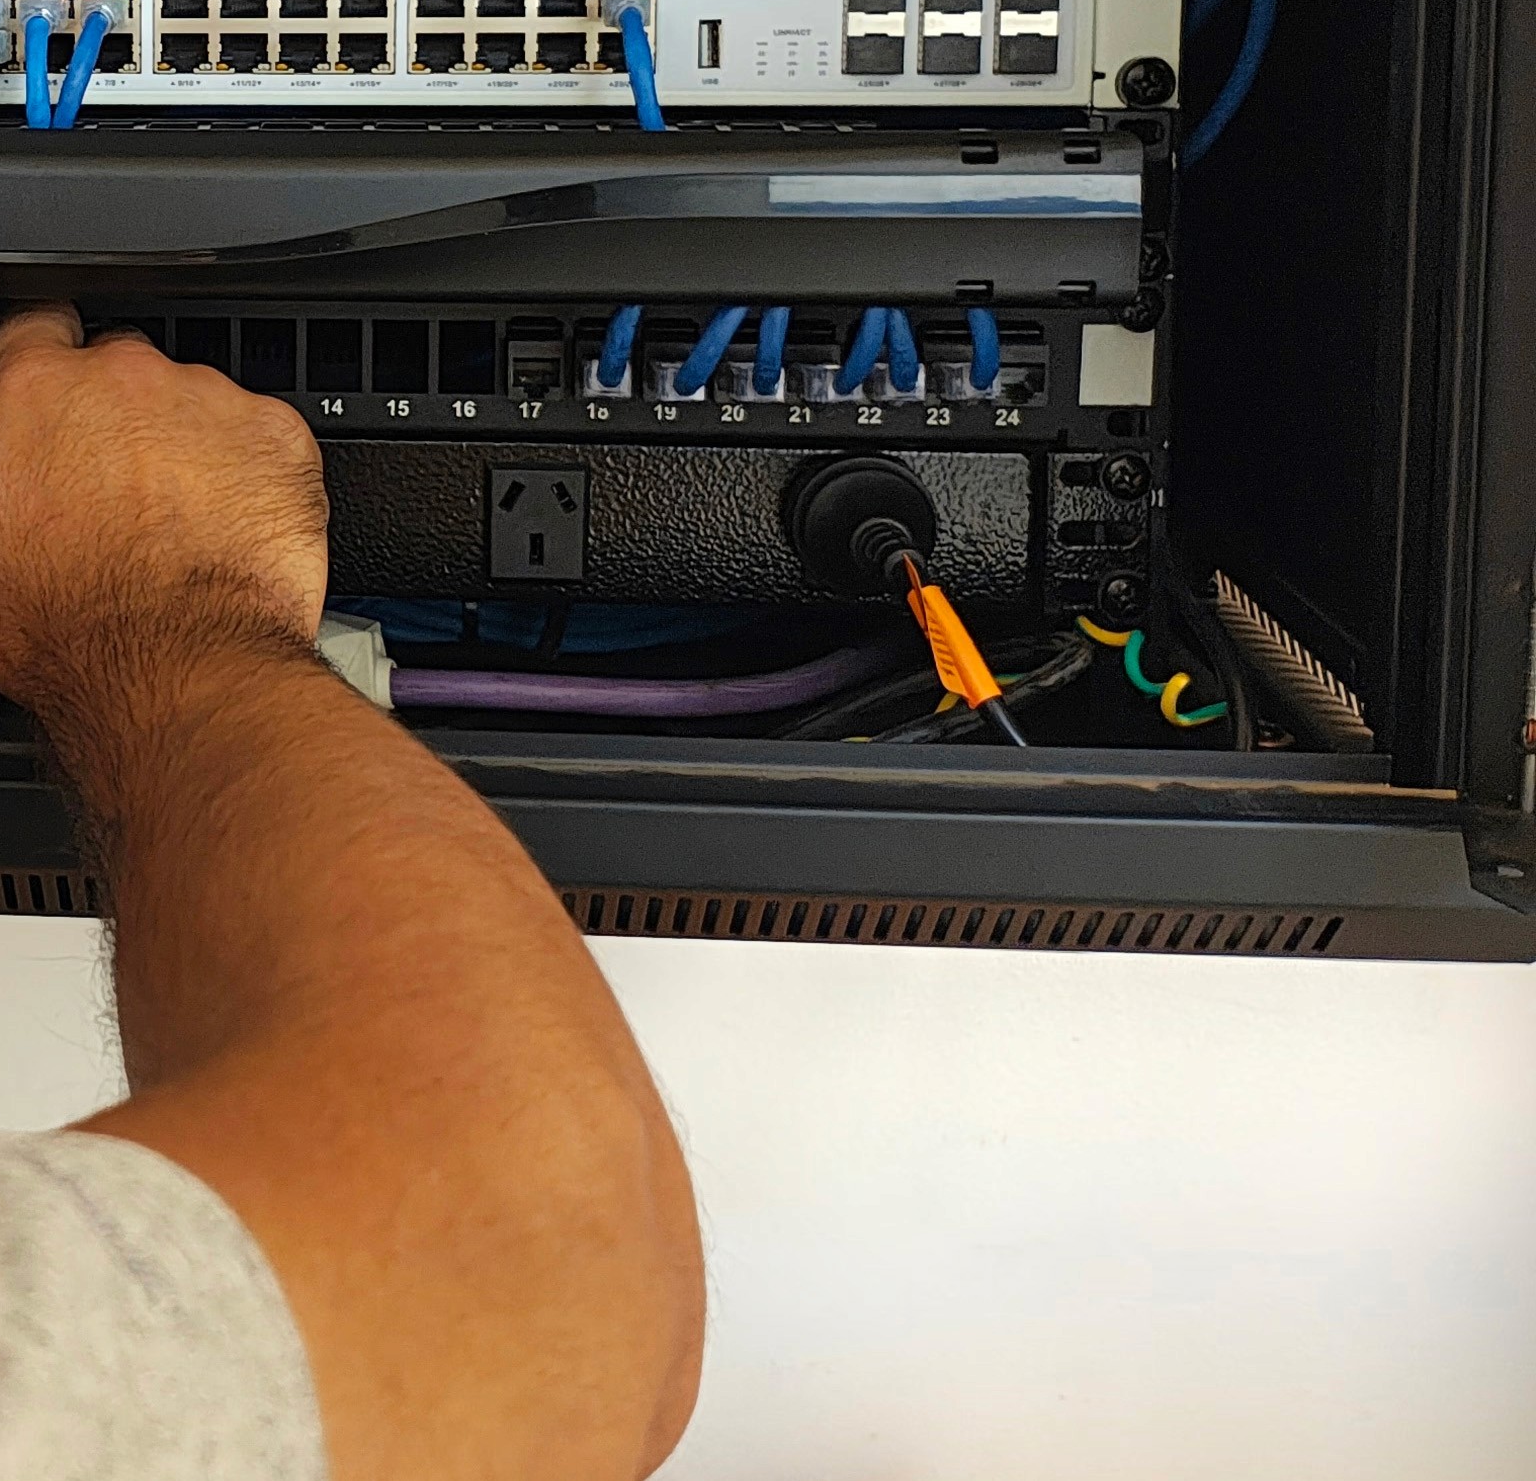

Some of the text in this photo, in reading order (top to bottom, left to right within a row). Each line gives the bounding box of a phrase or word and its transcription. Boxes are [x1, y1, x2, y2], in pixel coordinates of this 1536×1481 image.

[320, 398, 344, 416] 14
[386, 399, 410, 417] 15
[451, 400, 477, 418] 16
[518, 401, 543, 419] 17
[586, 402, 609, 420] 18
[653, 403, 678, 421] 19
[721, 404, 745, 422] 20
[788, 405, 811, 423] 21
[857, 406, 883, 425] 22
[926, 407, 951, 426] 23
[995, 408, 1020, 427] 24
